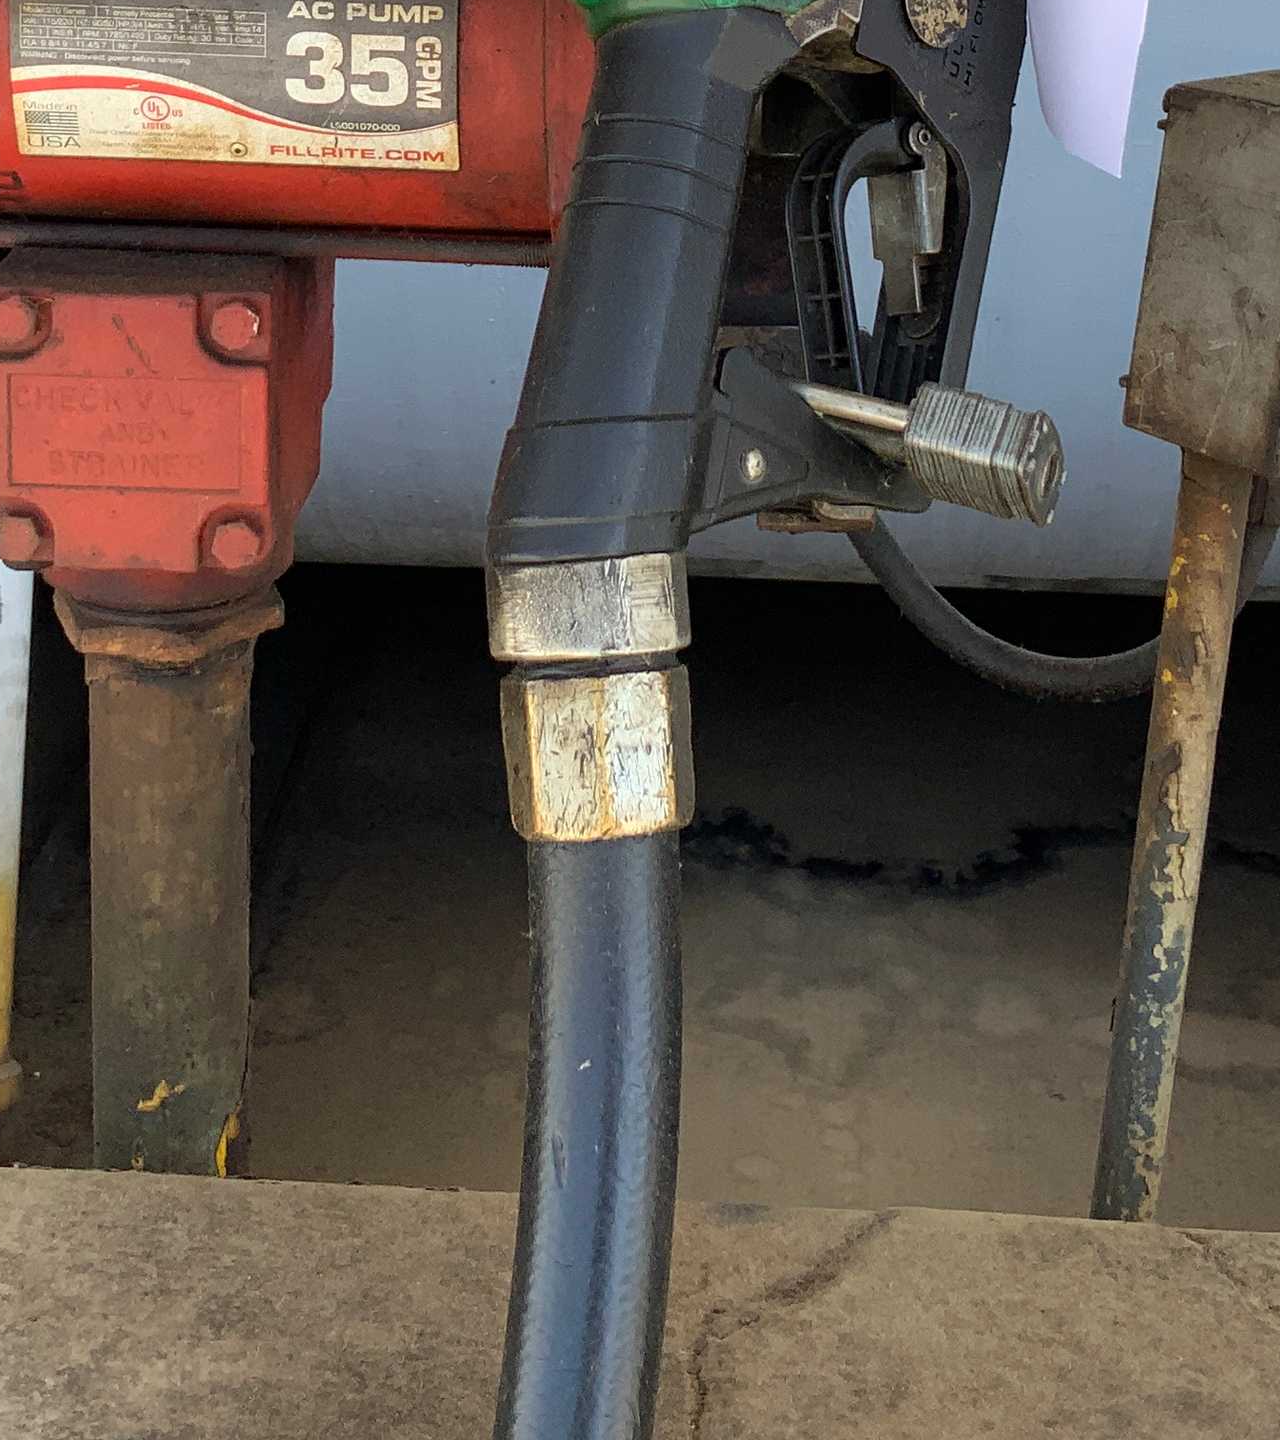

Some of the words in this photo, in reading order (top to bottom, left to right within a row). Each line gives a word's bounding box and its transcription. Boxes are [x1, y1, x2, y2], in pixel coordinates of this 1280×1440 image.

[287, 1, 334, 20] AC
[346, 3, 444, 23] PUMP
[285, 31, 409, 106] 35
[416, 36, 442, 109] GPM
[23, 100, 57, 111] Made
[172, 110, 183, 118] US
[28, 135, 81, 149] USA
[270, 144, 445, 163] FILLRITE.COM
